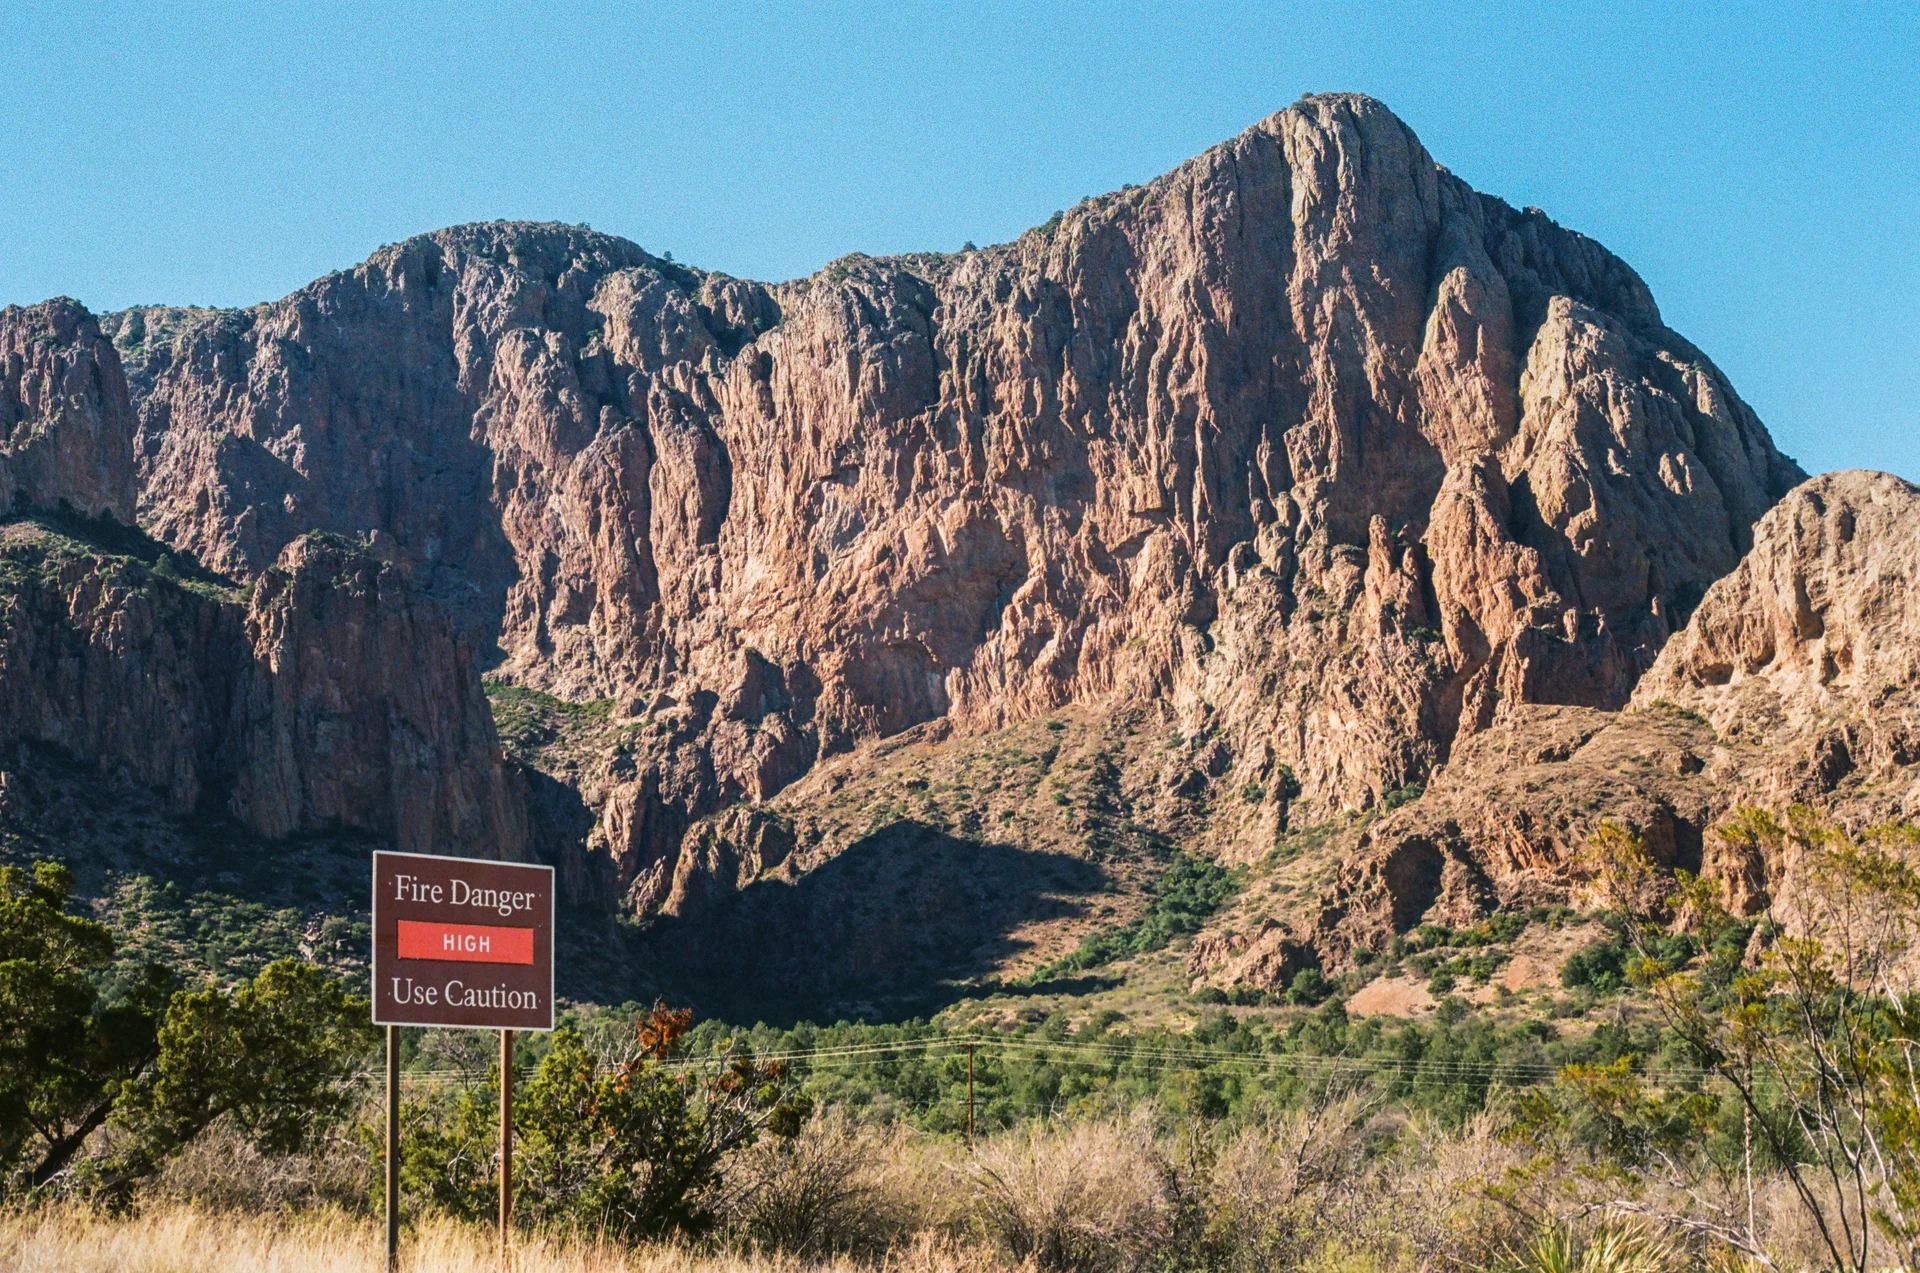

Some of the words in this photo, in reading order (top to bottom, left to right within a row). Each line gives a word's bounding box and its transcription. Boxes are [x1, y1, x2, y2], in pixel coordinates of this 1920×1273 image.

[394, 874, 443, 904] Fire
[449, 879, 535, 917] Danger
[443, 934, 490, 953] HIGH
[391, 977, 438, 1005] Use
[444, 980, 538, 1010] Caution
